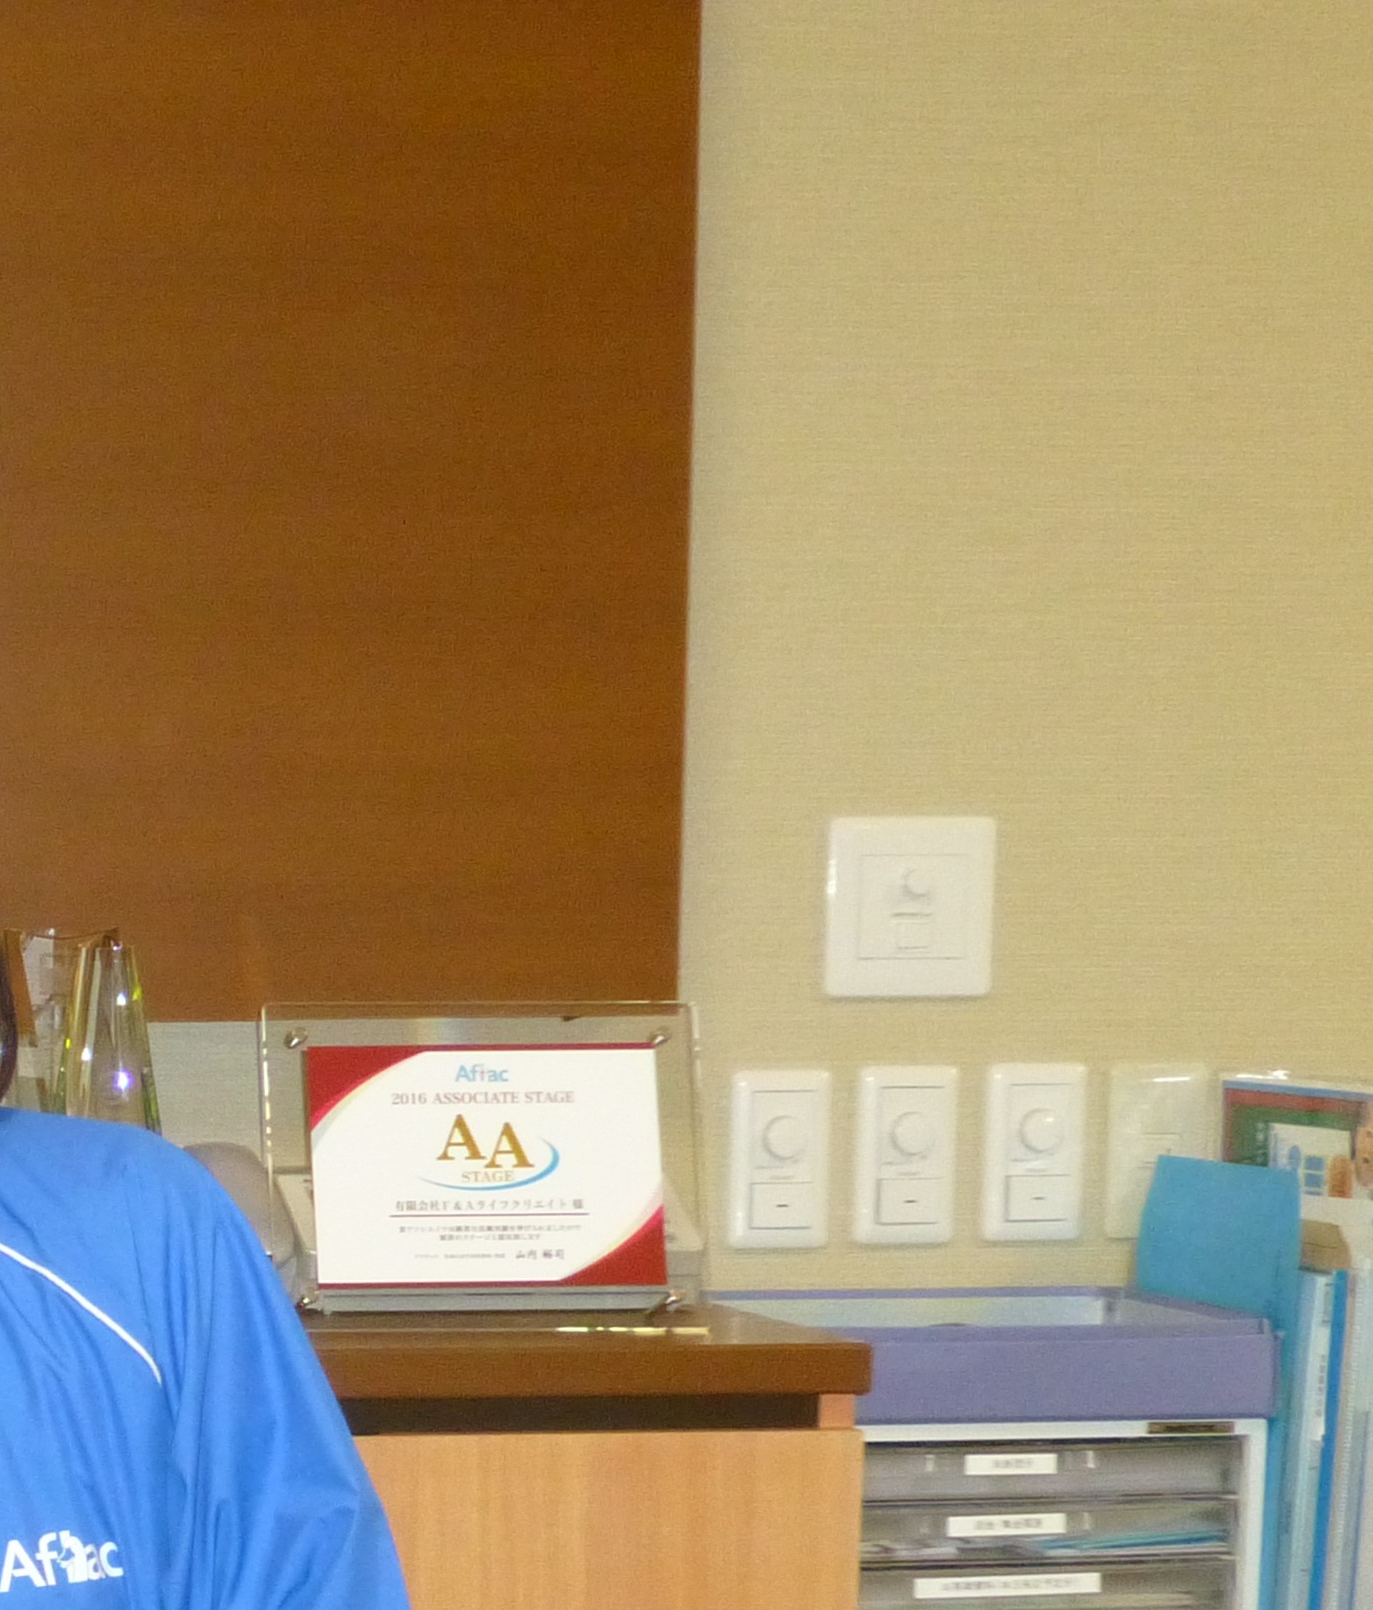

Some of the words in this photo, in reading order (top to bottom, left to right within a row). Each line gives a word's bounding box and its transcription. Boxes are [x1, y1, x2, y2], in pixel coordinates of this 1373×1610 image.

[391, 1092, 427, 1105] 2016
[433, 1092, 519, 1105] ASSOCIATE
[525, 1091, 575, 1104] STAGE
[436, 1114, 535, 1169] AA
[461, 1170, 515, 1183] STAGE
